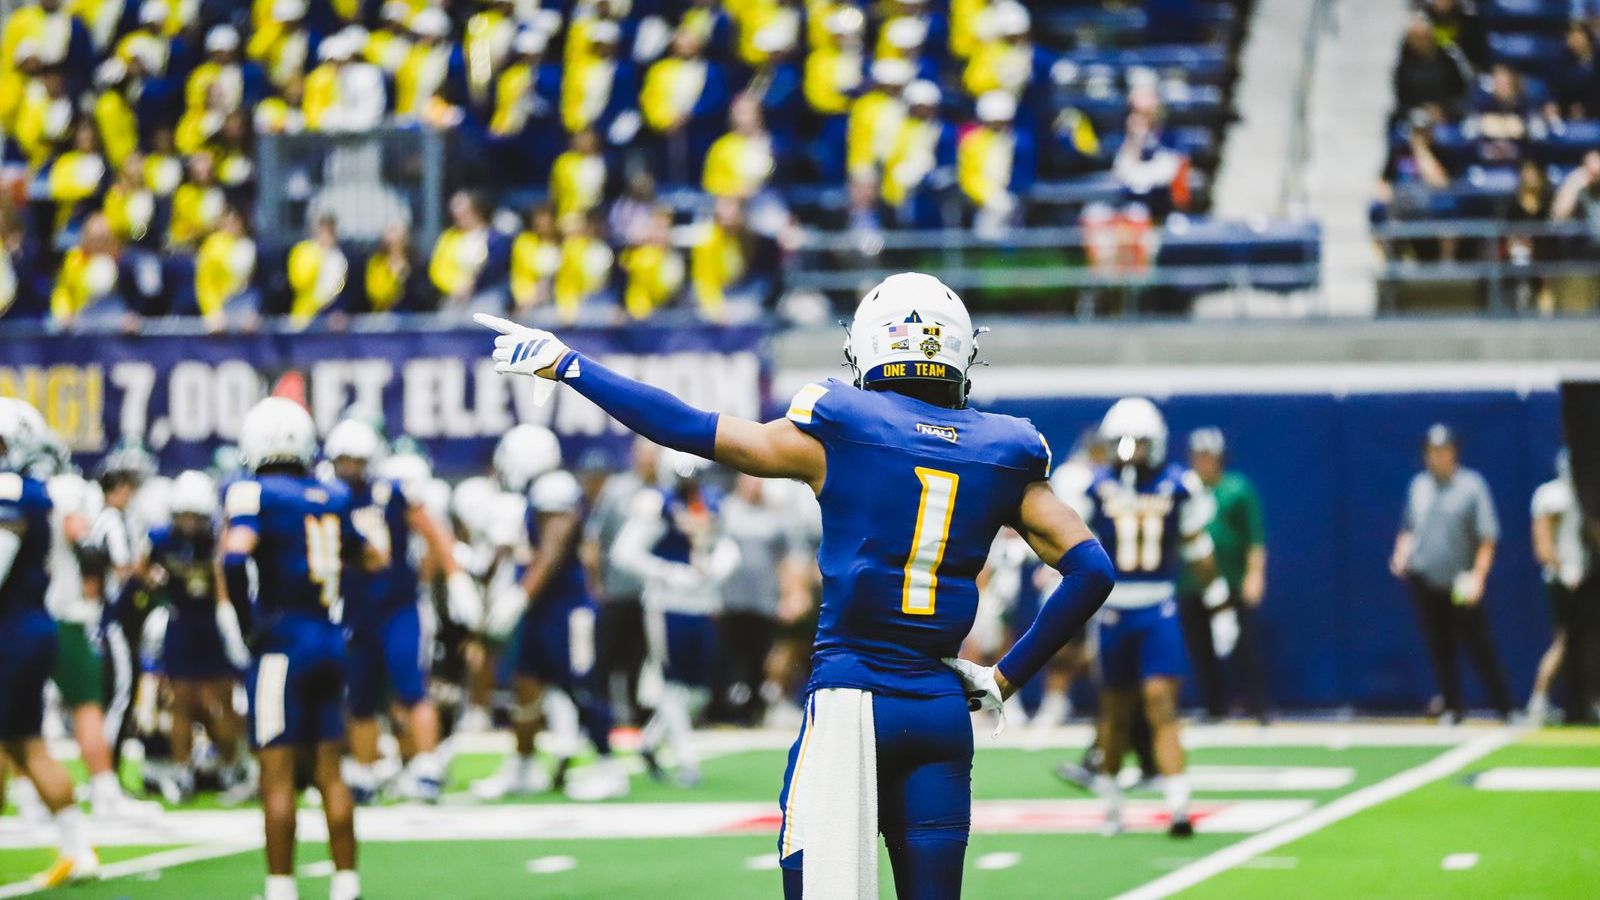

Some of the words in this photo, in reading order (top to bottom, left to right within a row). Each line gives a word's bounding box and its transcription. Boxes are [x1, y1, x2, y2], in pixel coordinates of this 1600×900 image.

[883, 363, 906, 377] ONE
[914, 363, 946, 377] TEAM
[111, 358, 273, 450] 7,00
[313, 358, 393, 438] FT
[921, 426, 953, 439] NAU
[902, 466, 959, 616] 1
[1115, 514, 1163, 572] 11
